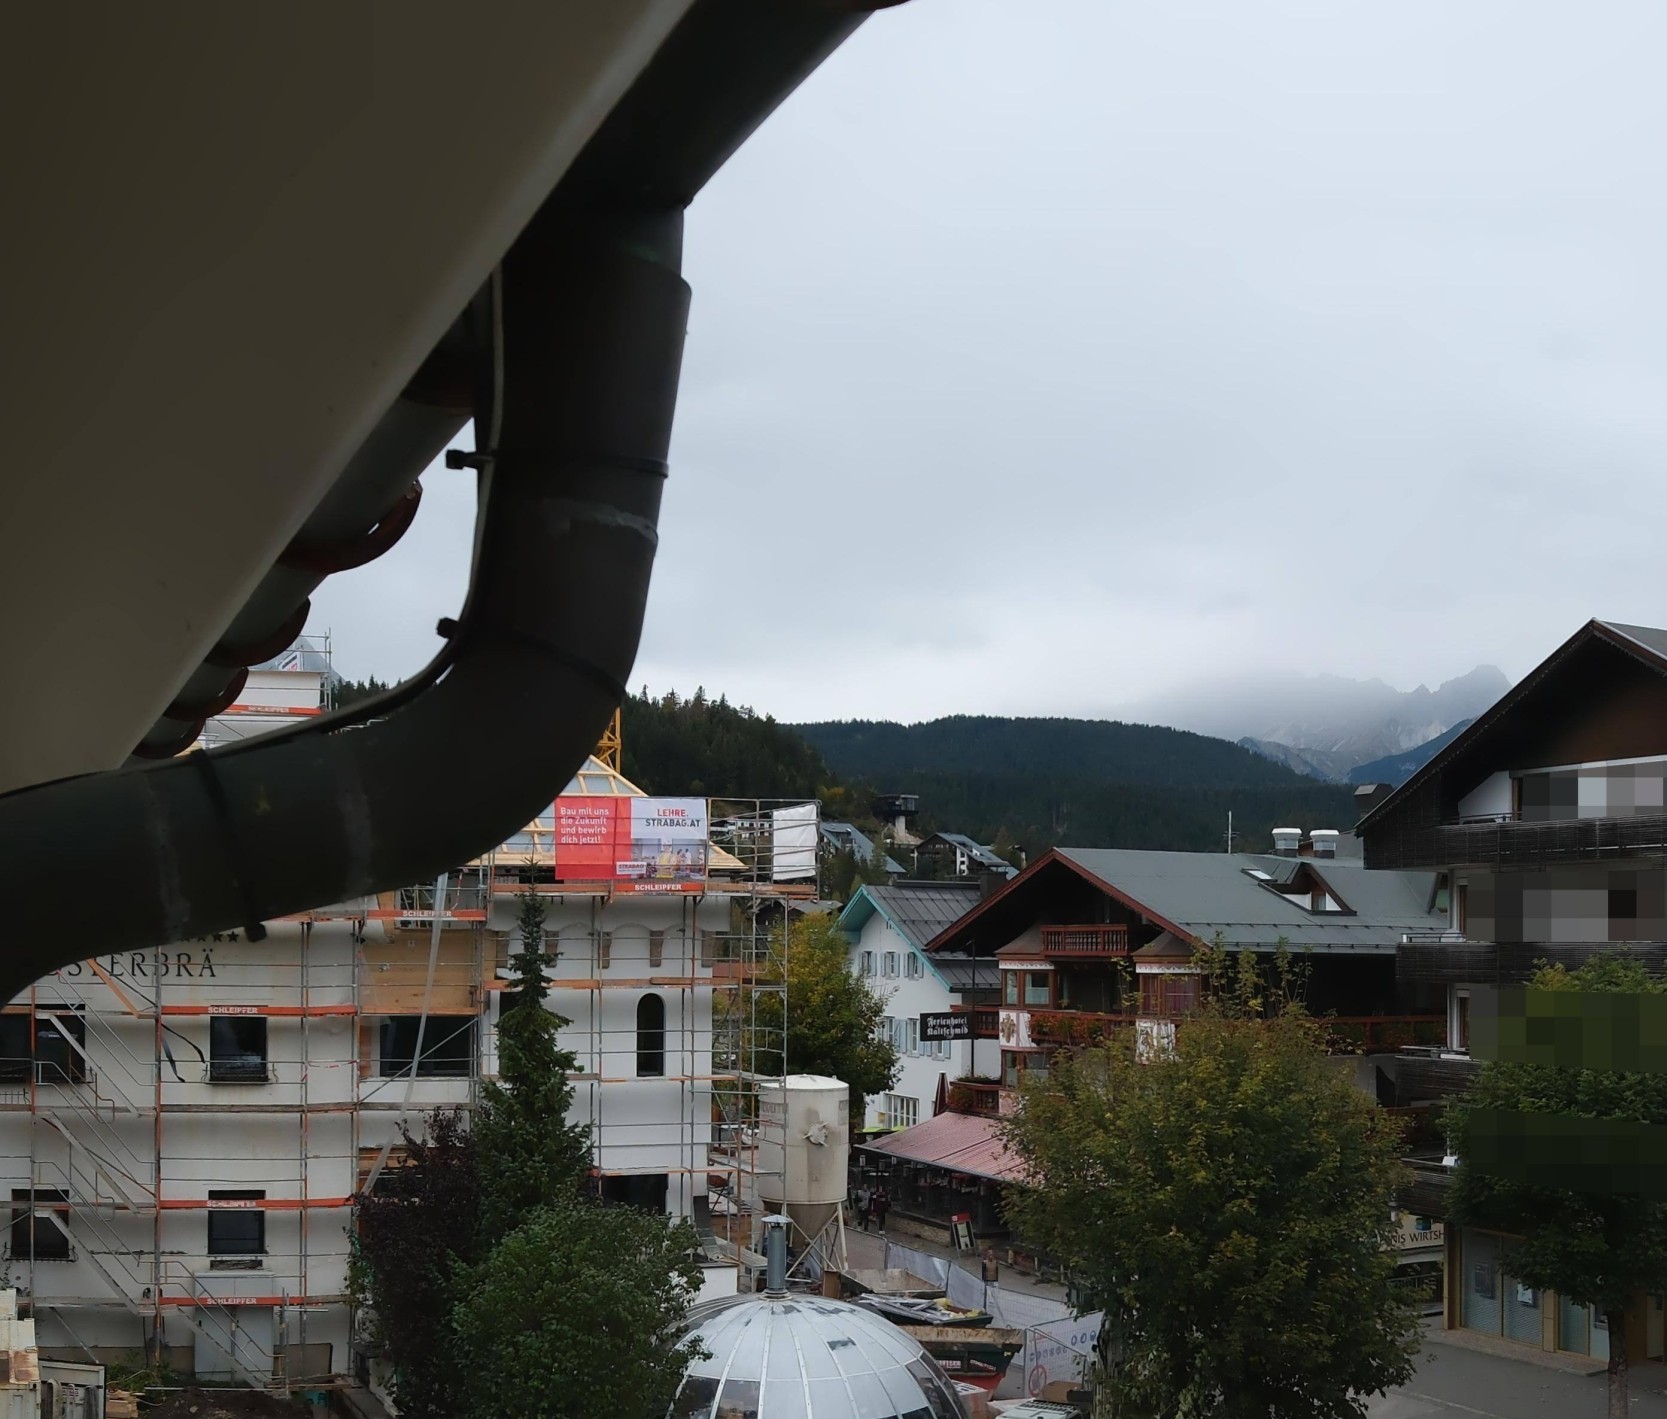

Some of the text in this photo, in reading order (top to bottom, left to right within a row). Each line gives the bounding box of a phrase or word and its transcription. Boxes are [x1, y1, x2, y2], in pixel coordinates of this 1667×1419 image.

[560, 807, 576, 816] Bau
[578, 807, 592, 815] mit
[657, 809, 689, 817] LEHRE.
[561, 816, 607, 825] die Zukunft
[645, 818, 701, 827] STRABAG.AT
[561, 826, 607, 834] und bewirb
[561, 836, 601, 845] dich jetzt!
[635, 883, 682, 891] SCHLEIPFER
[208, 1006, 258, 1014] SCHLEIPFER
